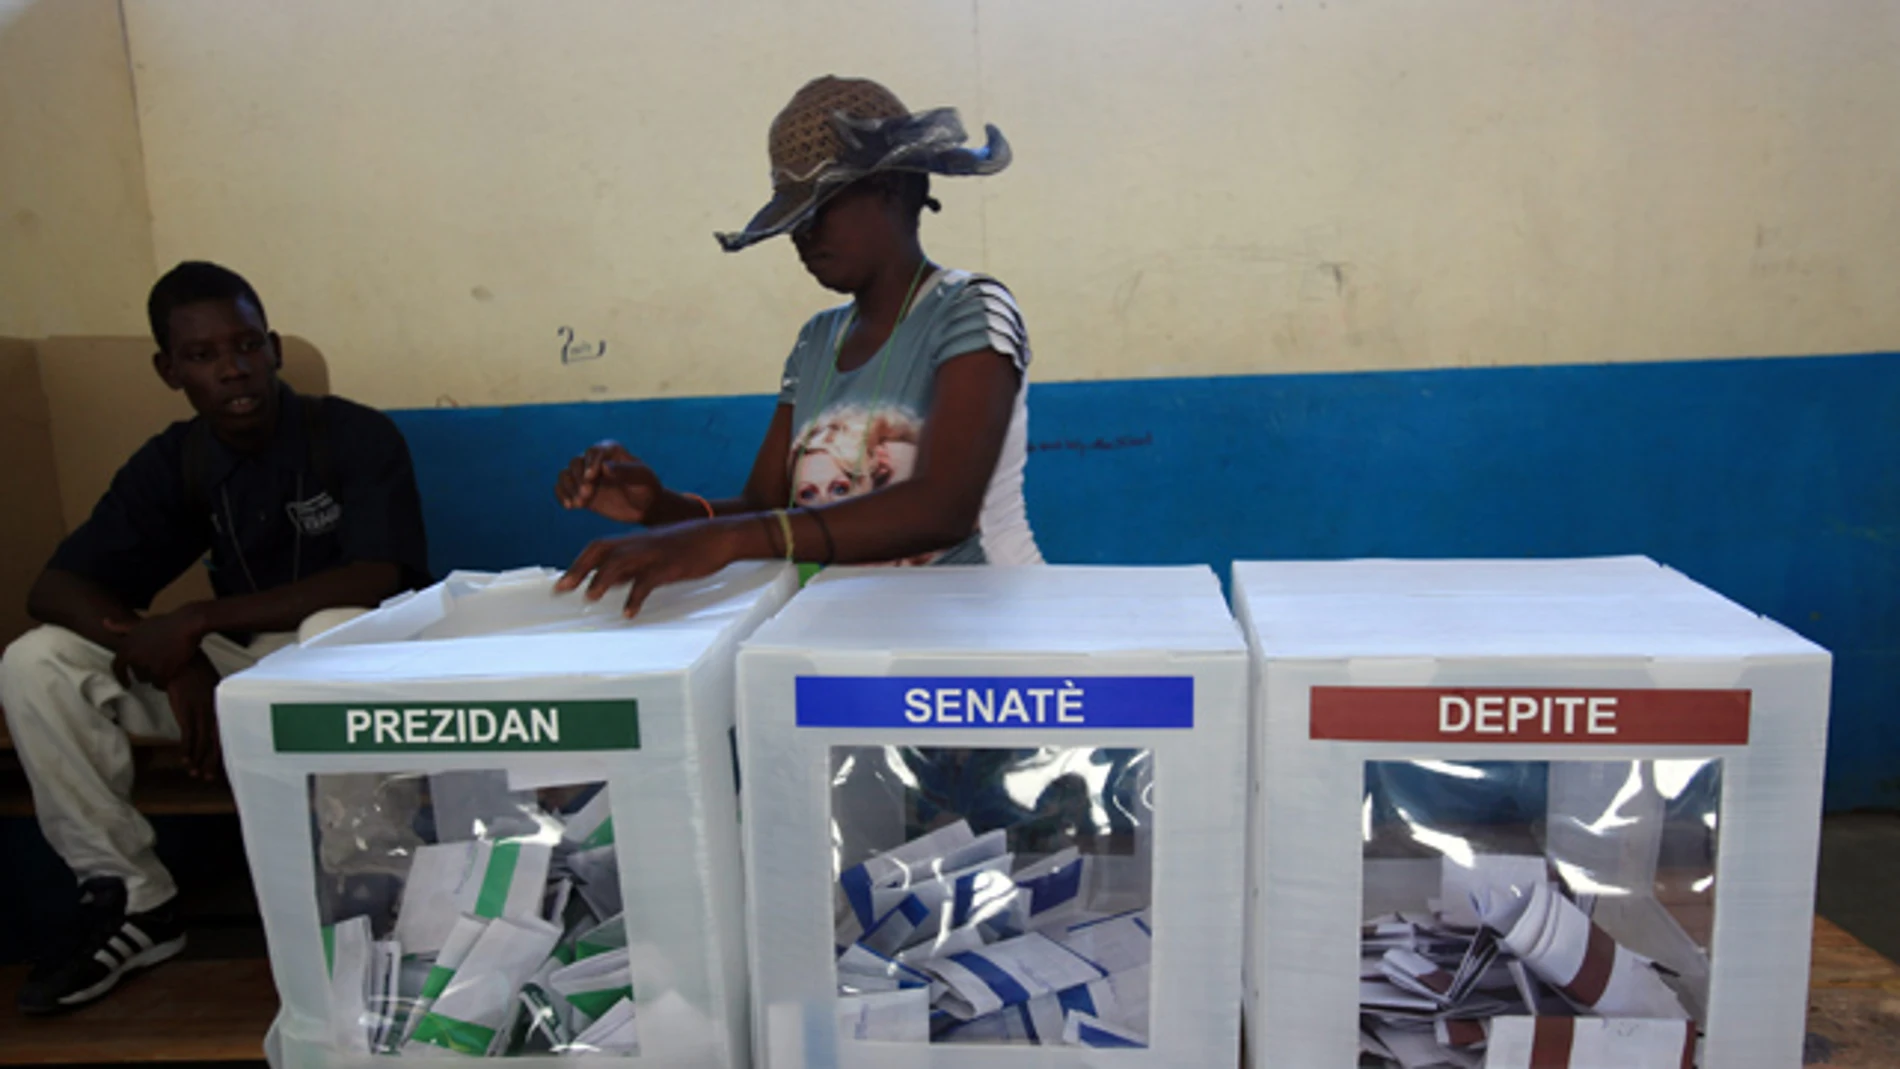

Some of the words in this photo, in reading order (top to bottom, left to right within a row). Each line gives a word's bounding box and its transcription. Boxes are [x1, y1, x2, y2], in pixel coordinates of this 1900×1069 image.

[905, 679, 1084, 723] SENATÈ
[1439, 696, 1618, 733] DEPITE
[346, 708, 559, 743] PREZIDAN
